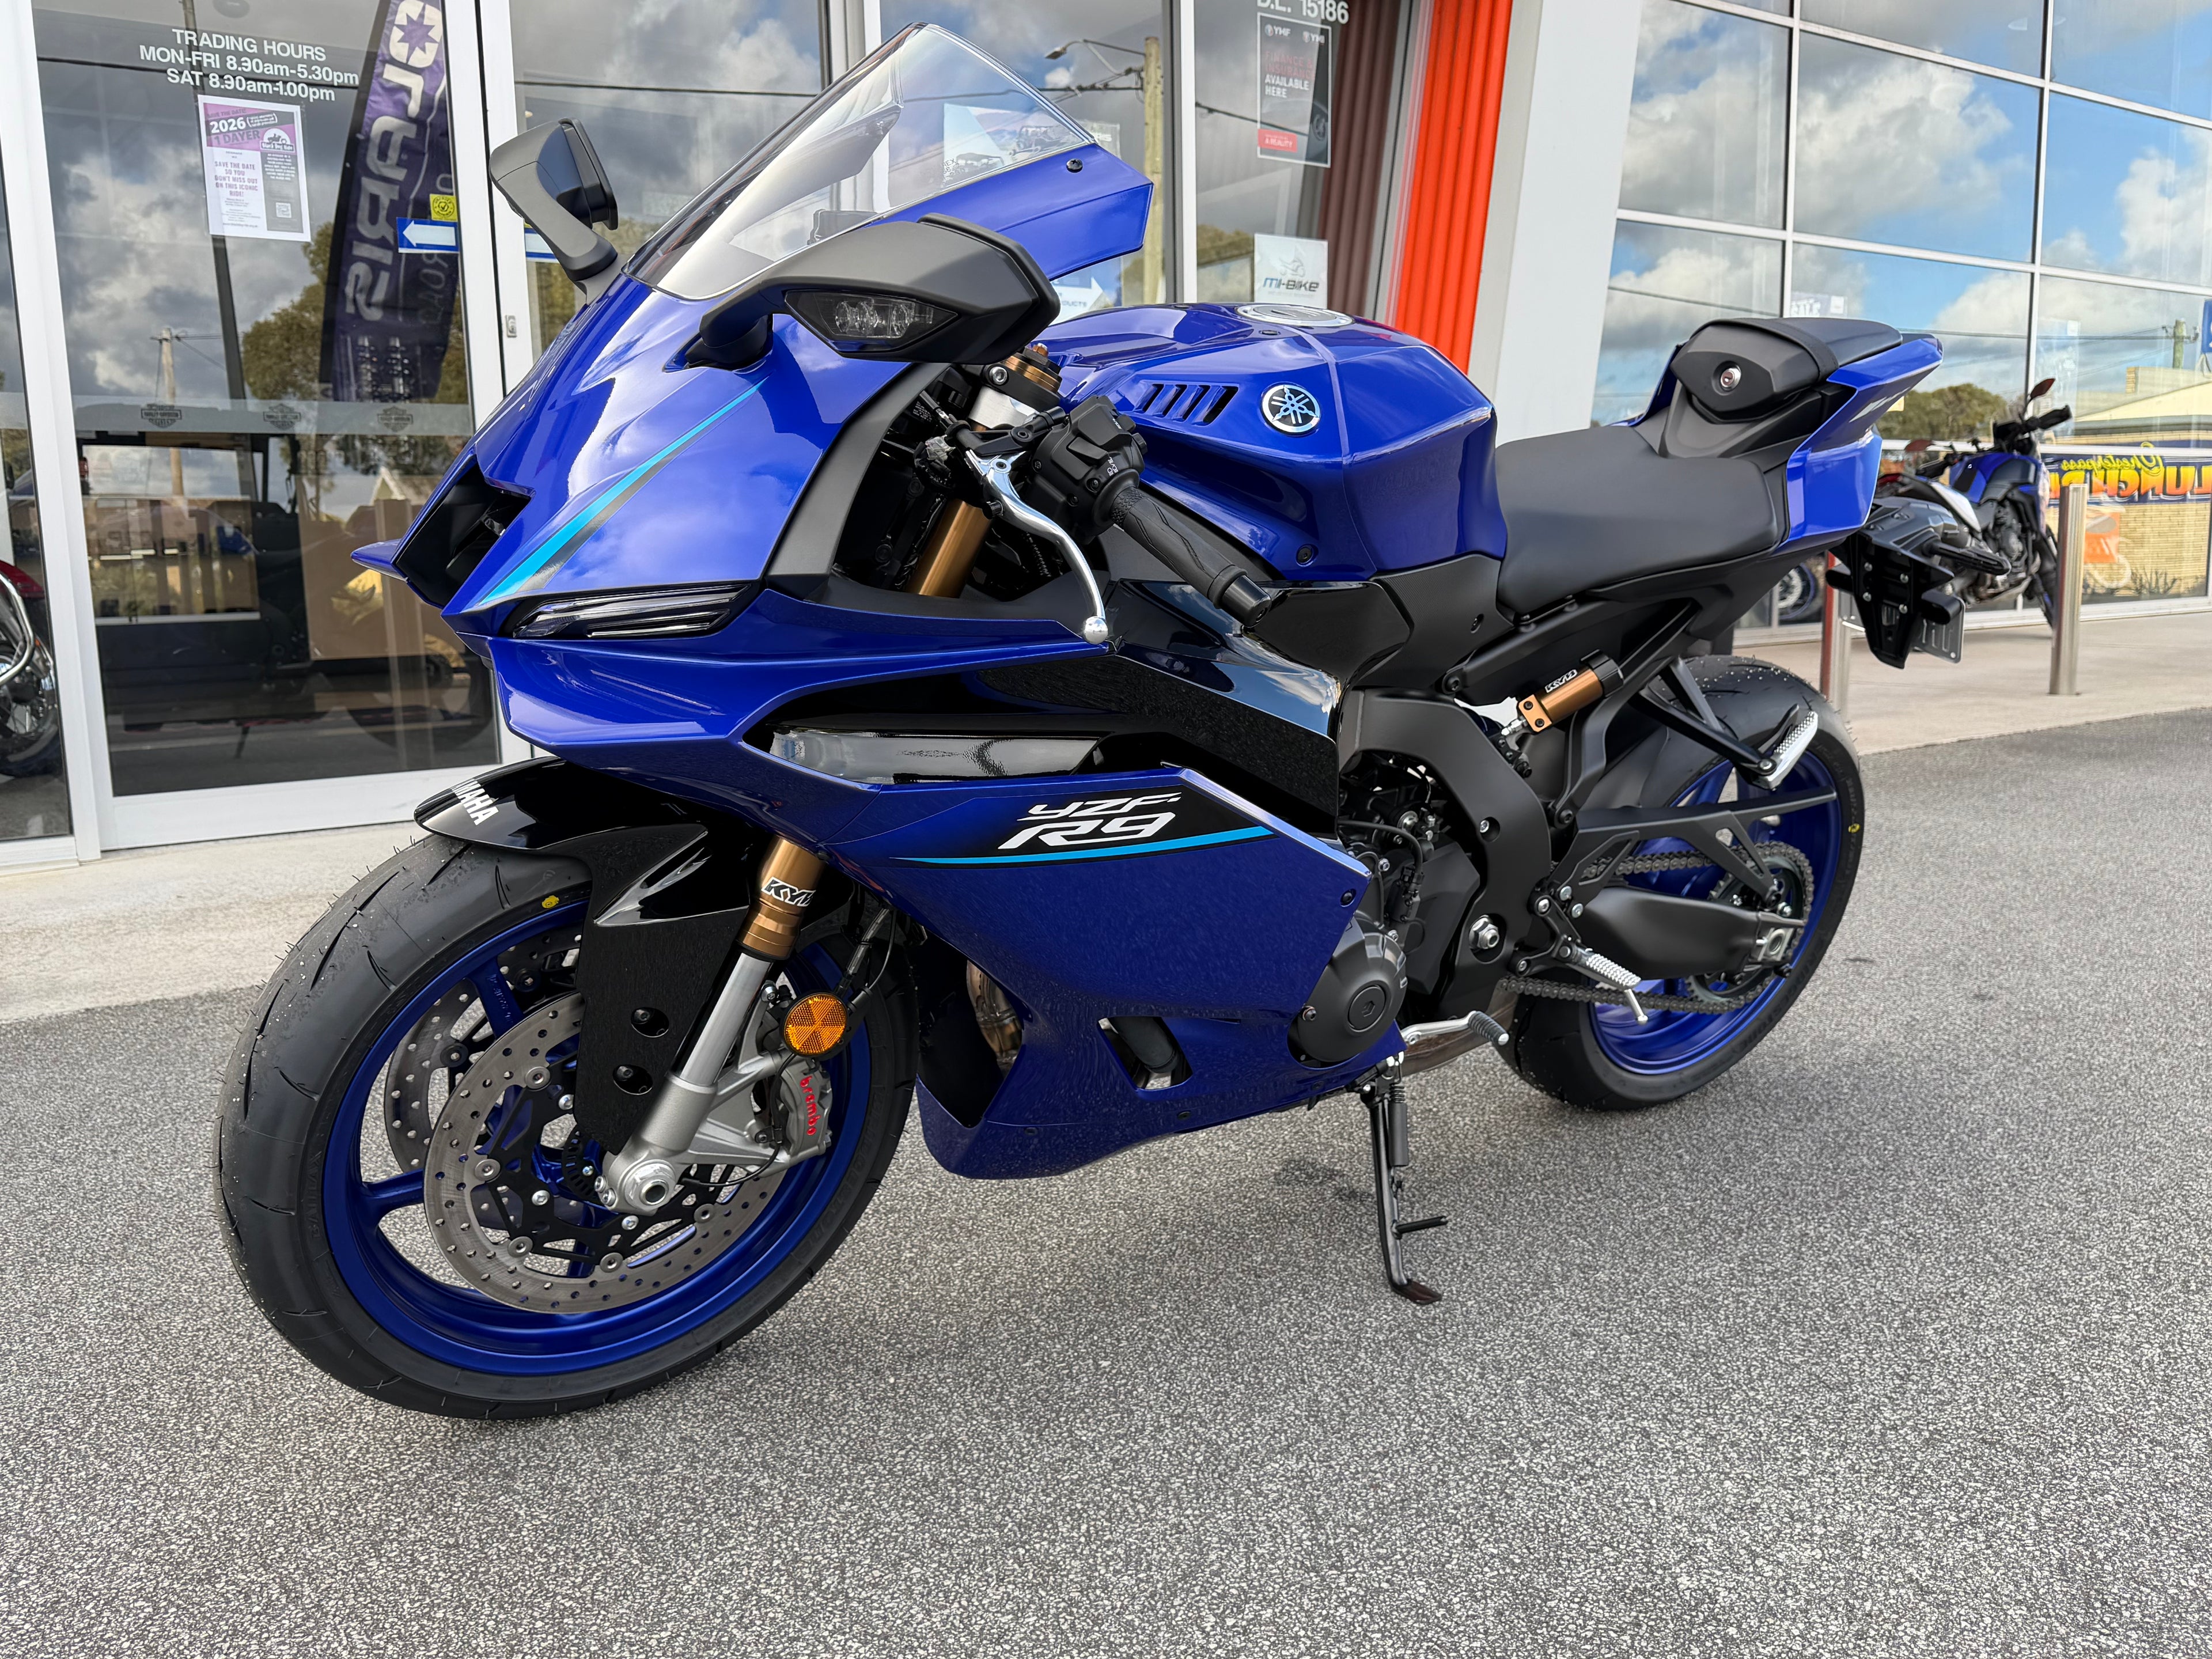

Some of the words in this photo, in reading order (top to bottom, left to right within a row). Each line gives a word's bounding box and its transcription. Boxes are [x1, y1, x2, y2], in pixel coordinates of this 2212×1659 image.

[1302, 0, 1349, 24] 15186
[172, 29, 257, 54] TRADING
[263, 40, 327, 62] HOURS
[139, 45, 220, 69] MON-FRI
[226, 55, 359, 86] 8.30am-5.30pm
[166, 67, 203, 86] SAT
[208, 75, 336, 102] 8.30am-1.00pm
[1264, 74, 1309, 90] AVAILABLE
[1265, 85, 1287, 98] HERE
[210, 117, 246, 134] 2026
[223, 130, 260, 145] DAYER
[1544, 669, 1578, 694] KYB
[998, 812, 1176, 850] R9
[800, 1075, 821, 1136] brembo
